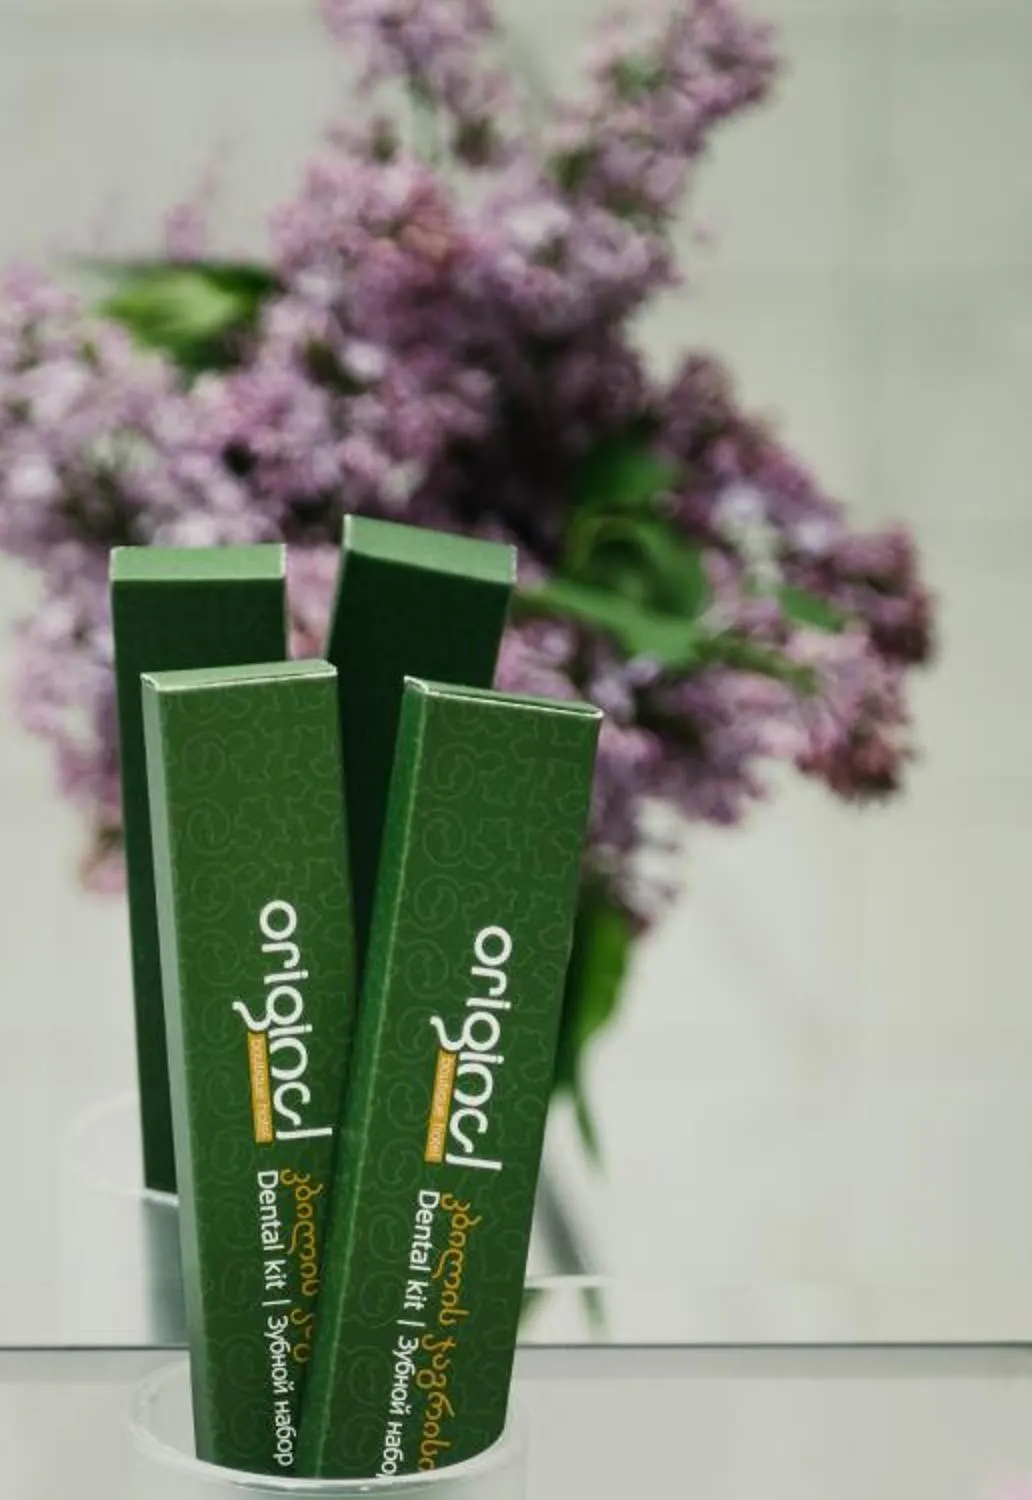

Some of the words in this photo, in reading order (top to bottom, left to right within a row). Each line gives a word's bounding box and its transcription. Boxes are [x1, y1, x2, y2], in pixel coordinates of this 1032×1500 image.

[257, 1170, 286, 1251] Dental
[409, 1189, 440, 1271] Dental
[264, 1259, 287, 1291] kit
[403, 1279, 429, 1311] kit
[431, 1193, 483, 1326] კბილის
[264, 1315, 295, 1394] Зубной
[389, 1335, 420, 1415] Зубной
[272, 1400, 297, 1467] набор
